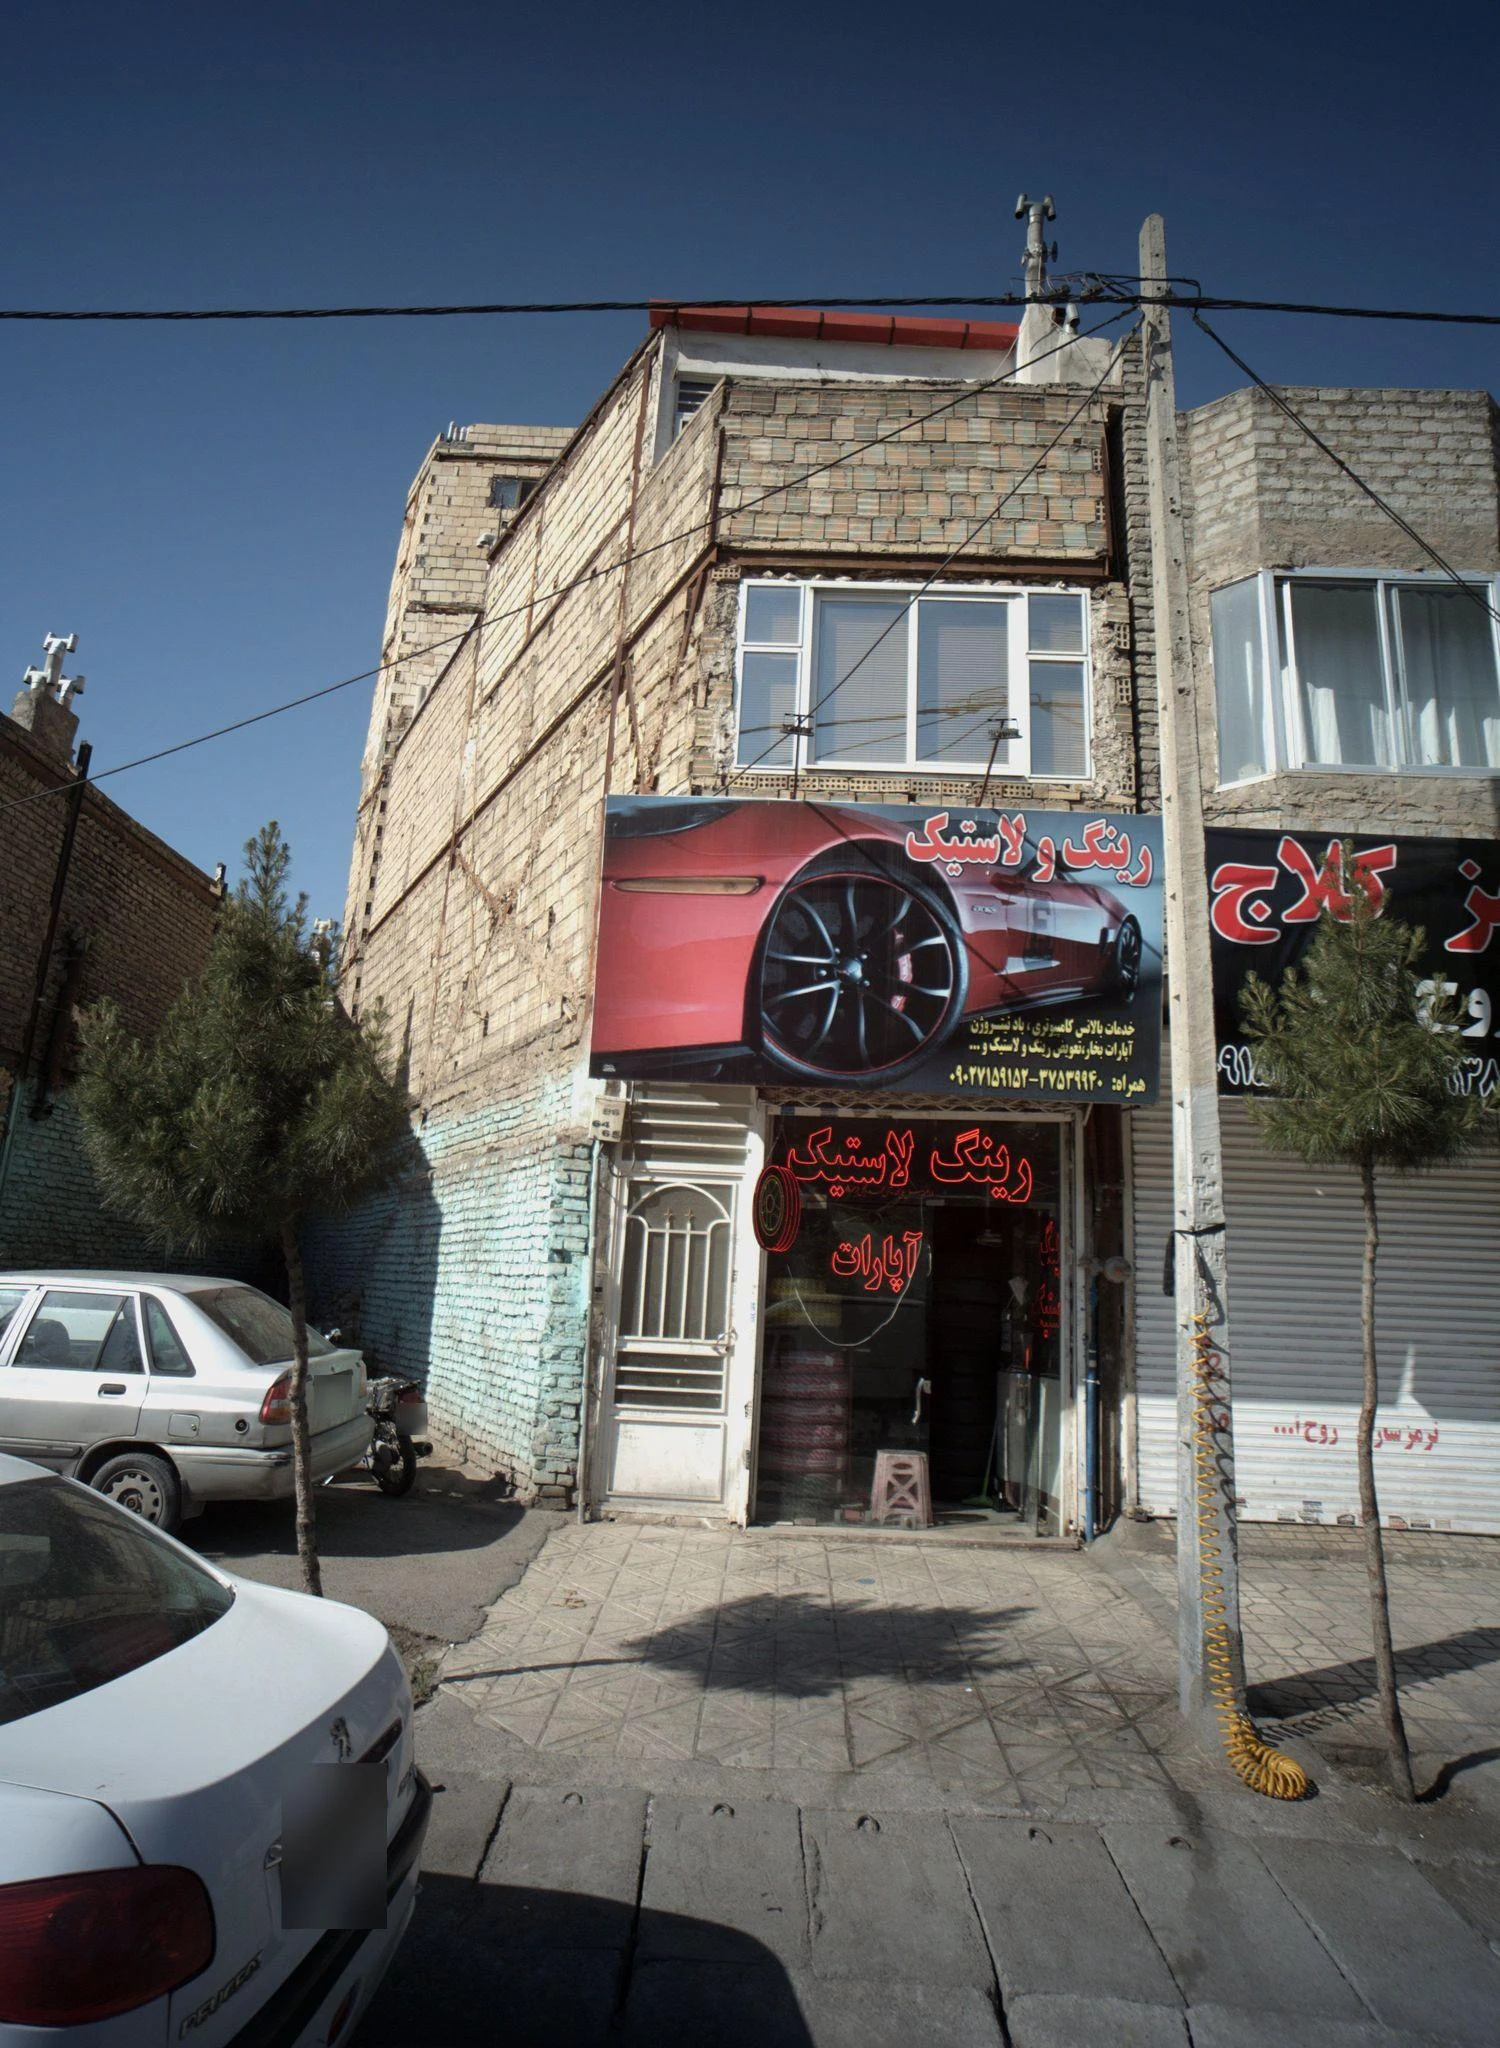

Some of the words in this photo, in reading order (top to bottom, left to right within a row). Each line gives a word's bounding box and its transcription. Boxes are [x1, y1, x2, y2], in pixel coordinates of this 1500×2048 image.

[906, 811, 1026, 877] لاستیک
[1062, 818, 1153, 887] رینگ
[1033, 836, 1056, 882] و
[1012, 1016, 1025, 1036] باد
[1074, 1018, 1104, 1039] بالانس
[1104, 1020, 1136, 1036] خدمات
[989, 1036, 1020, 1056] لاستیک
[1020, 1043, 1027, 1058] و
[1104, 1039, 1134, 1063] آپارات
[786, 1126, 915, 1197] لاستیک
[930, 1128, 1033, 1203] رینگ
[831, 1230, 924, 1294] آپارات
[1303, 1420, 1339, 1446] روح
